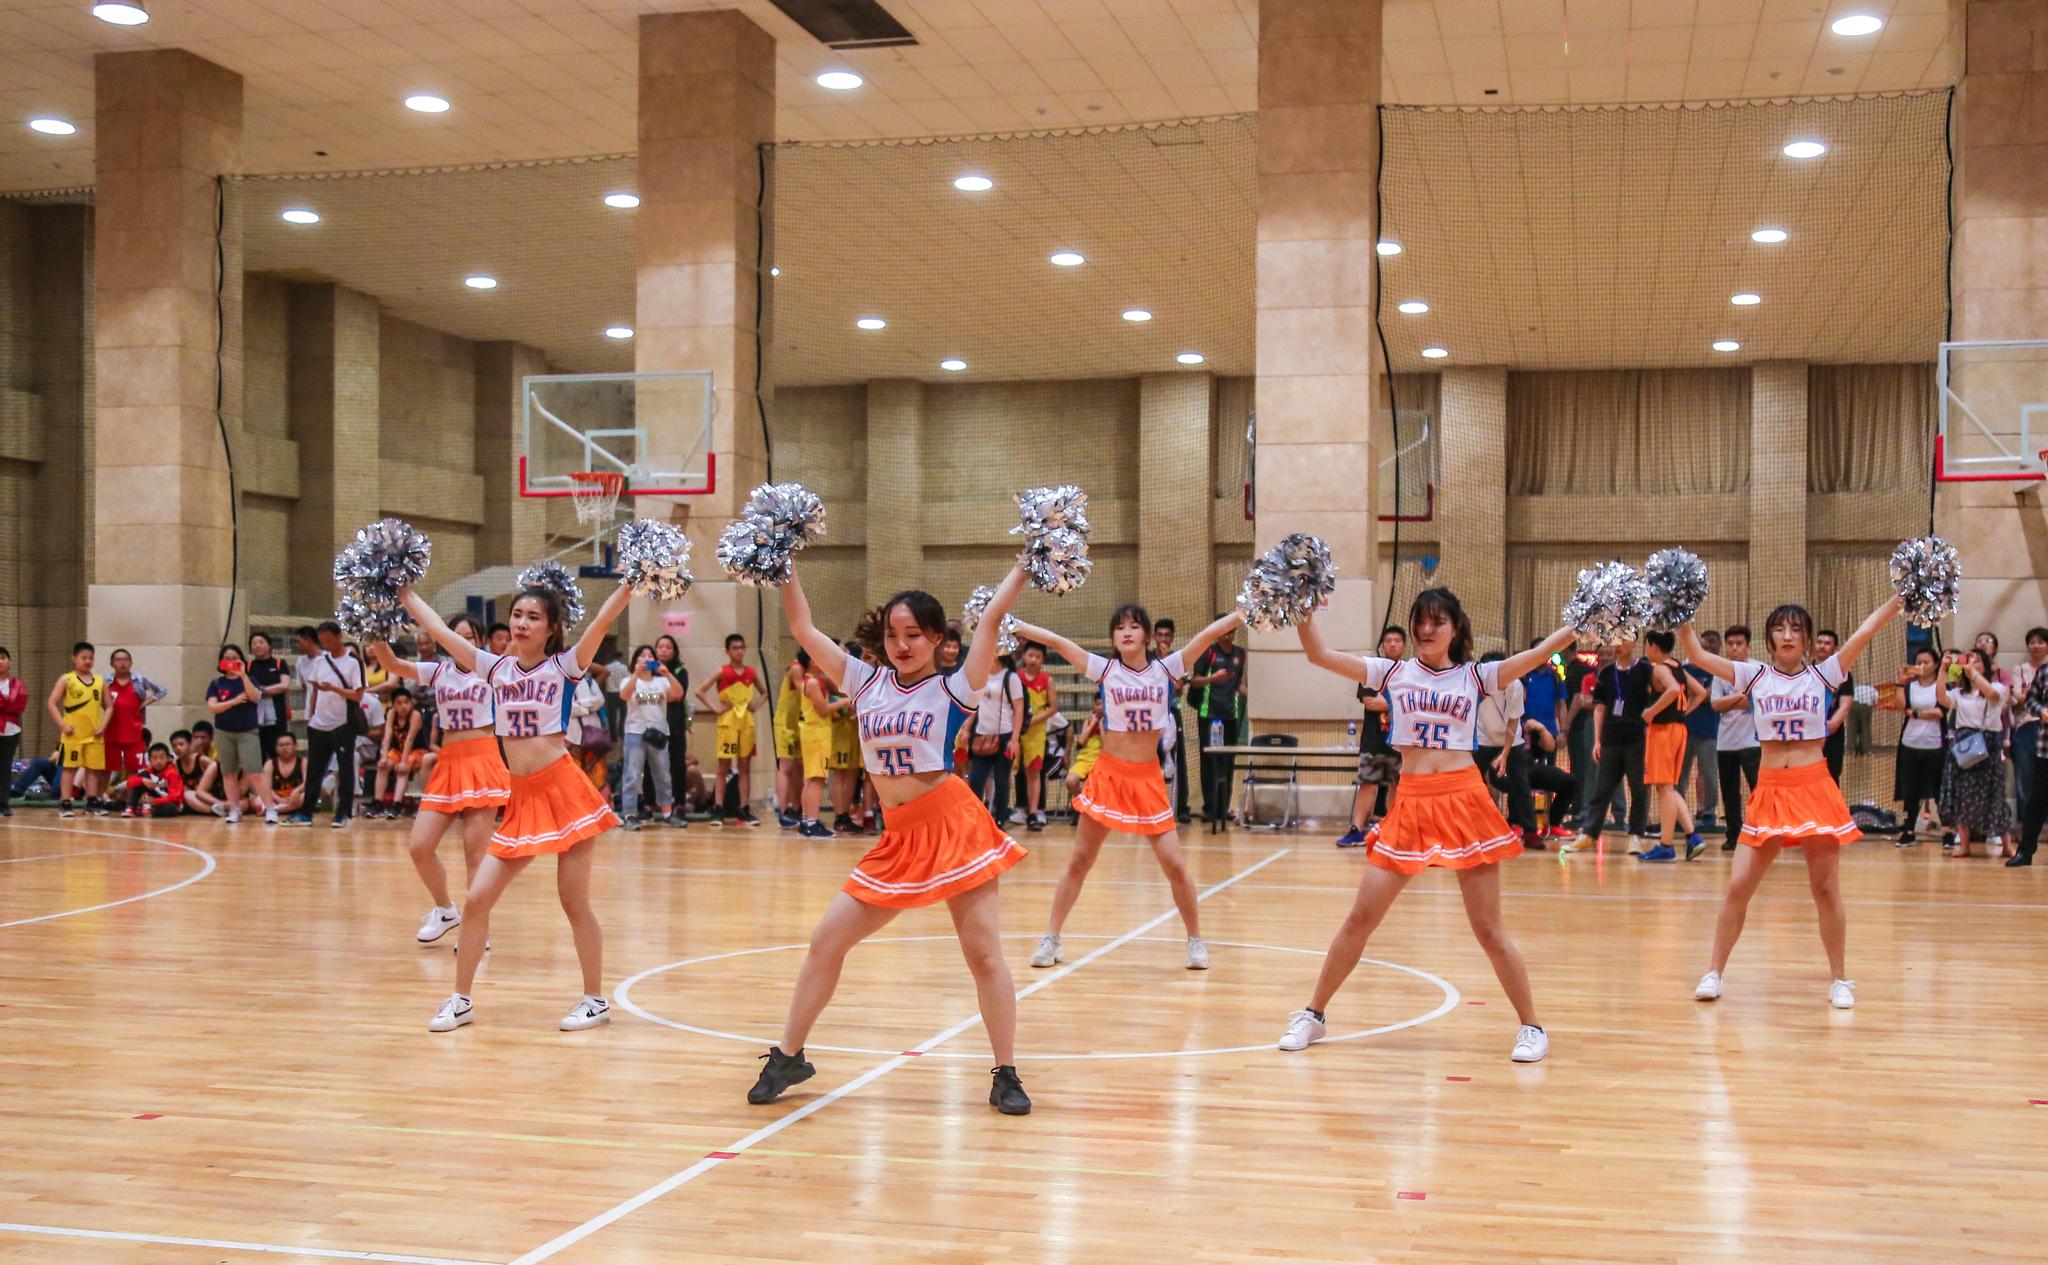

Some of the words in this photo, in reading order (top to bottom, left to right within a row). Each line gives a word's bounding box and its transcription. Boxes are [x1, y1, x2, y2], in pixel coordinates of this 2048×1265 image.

[1398, 688, 1472, 723] THUNDER
[447, 708, 474, 730] 35
[506, 710, 541, 736] 35
[1124, 709, 1152, 732] 35
[1772, 718, 1804, 741] 35
[1413, 720, 1451, 750] 35
[875, 746, 914, 776] 35
